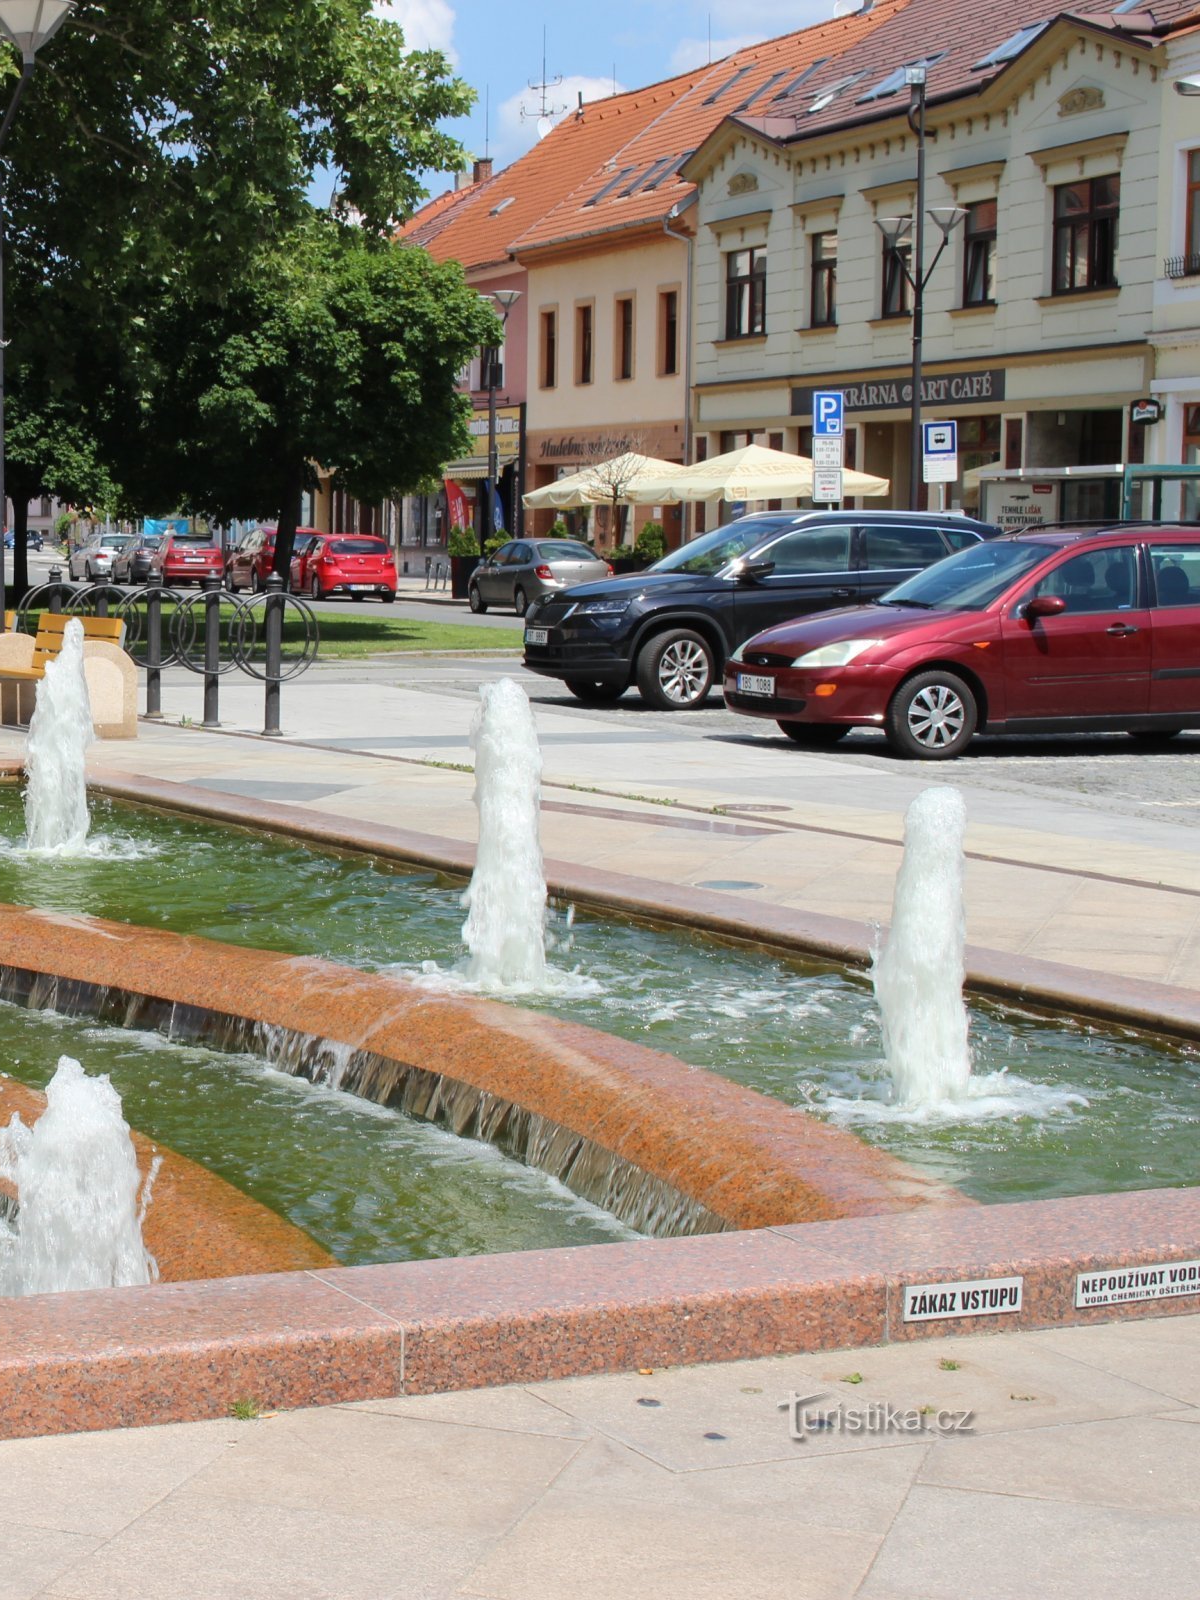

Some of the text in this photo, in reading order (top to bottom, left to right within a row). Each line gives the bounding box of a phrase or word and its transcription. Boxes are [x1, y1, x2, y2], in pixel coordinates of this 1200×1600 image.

[840, 371, 992, 408] KRÁRNA ART CAFÉ
[820, 397, 837, 423] P
[997, 516, 1044, 524] SE NEVYTAHUJE
[1001, 504, 1042, 514] TENHLE LIŠÁK
[1081, 1265, 1200, 1294] NEPOUŽÍVAT VOD
[910, 1287, 1018, 1315] ZÁKAZ VSTUPU
[1085, 1295, 1108, 1304] VODA
[1111, 1289, 1157, 1301] CHEMICKY
